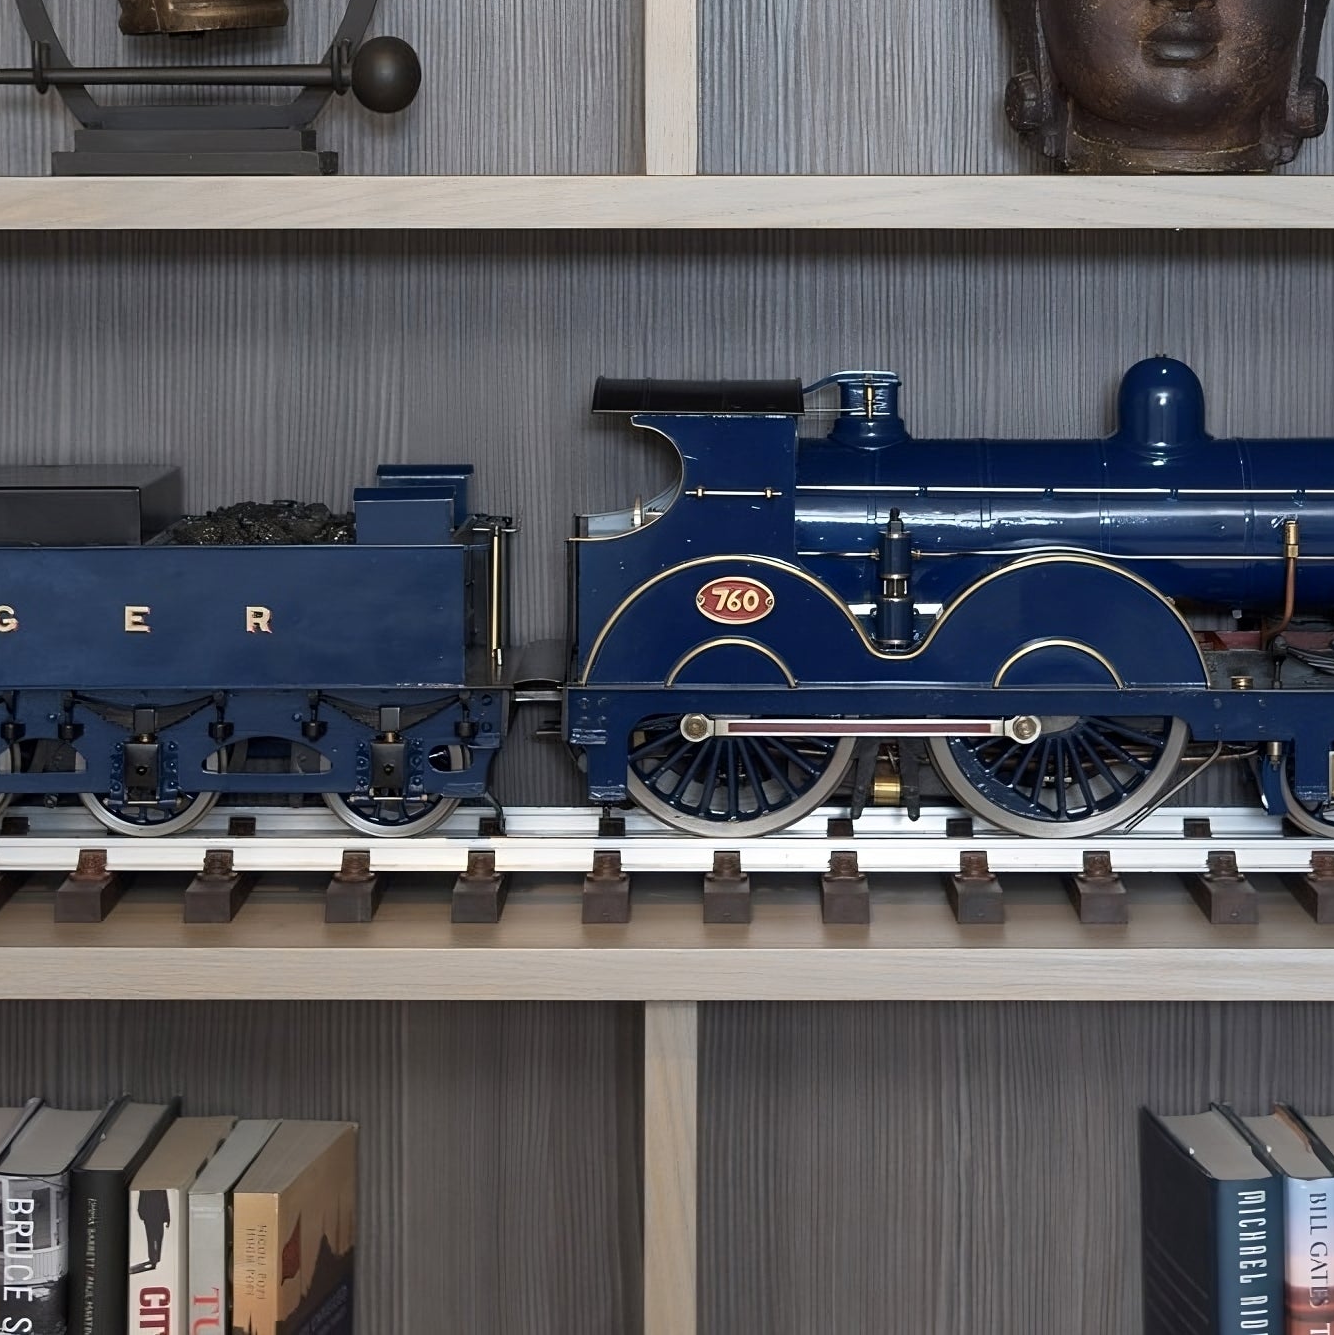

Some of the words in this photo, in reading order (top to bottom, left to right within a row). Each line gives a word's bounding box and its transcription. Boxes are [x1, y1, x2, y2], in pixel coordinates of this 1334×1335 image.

[124, 605, 151, 633] E
[246, 605, 272, 634] R
[711, 587, 760, 613] 760
[1237, 1190, 1268, 1284] MICHAEL
[1309, 1192, 1328, 1235] BILL
[3, 1198, 35, 1302] BRUCE
[1309, 1241, 1330, 1309] GATES
